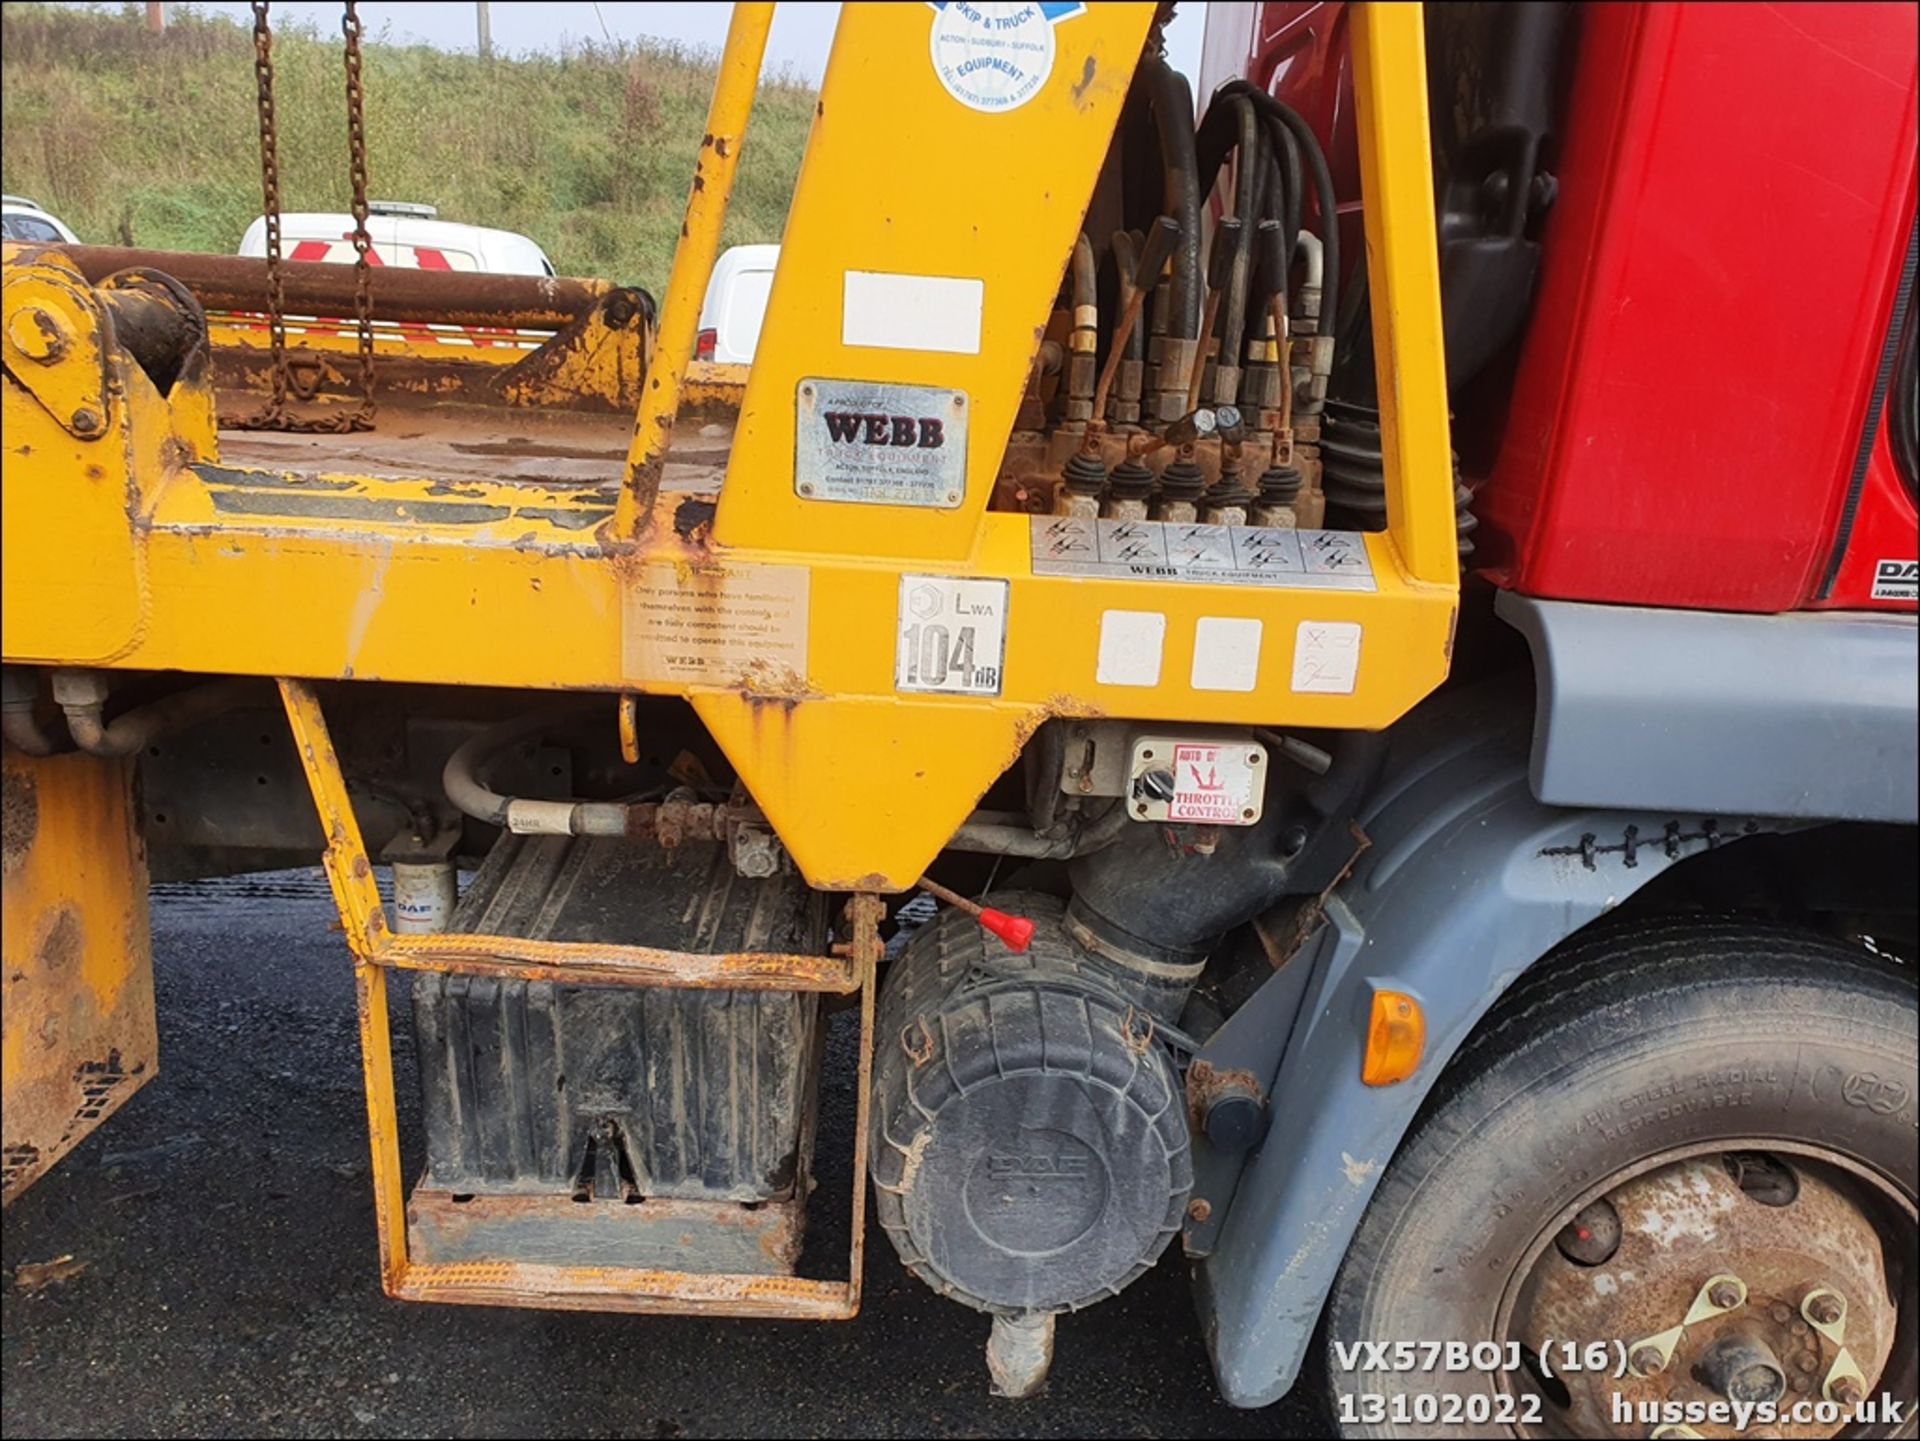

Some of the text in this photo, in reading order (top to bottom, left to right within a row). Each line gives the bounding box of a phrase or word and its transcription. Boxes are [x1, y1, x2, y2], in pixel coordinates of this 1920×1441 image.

[983, 16, 991, 29] &
[995, 5, 1035, 30] TRUCK
[971, 37, 1006, 48] SUDBURY
[1011, 41, 1045, 53] SUFFOLK
[956, 56, 1024, 82] EQUIPMENT
[824, 411, 945, 448] WEBB
[1130, 565, 1178, 576] WEBB
[903, 623, 976, 687] 104
[1179, 750, 1202, 762] AUTO
[1175, 791, 1240, 806] THROTTL
[398, 903, 432, 914] DAF
[1694, 1067, 1778, 1091] RADIAL
